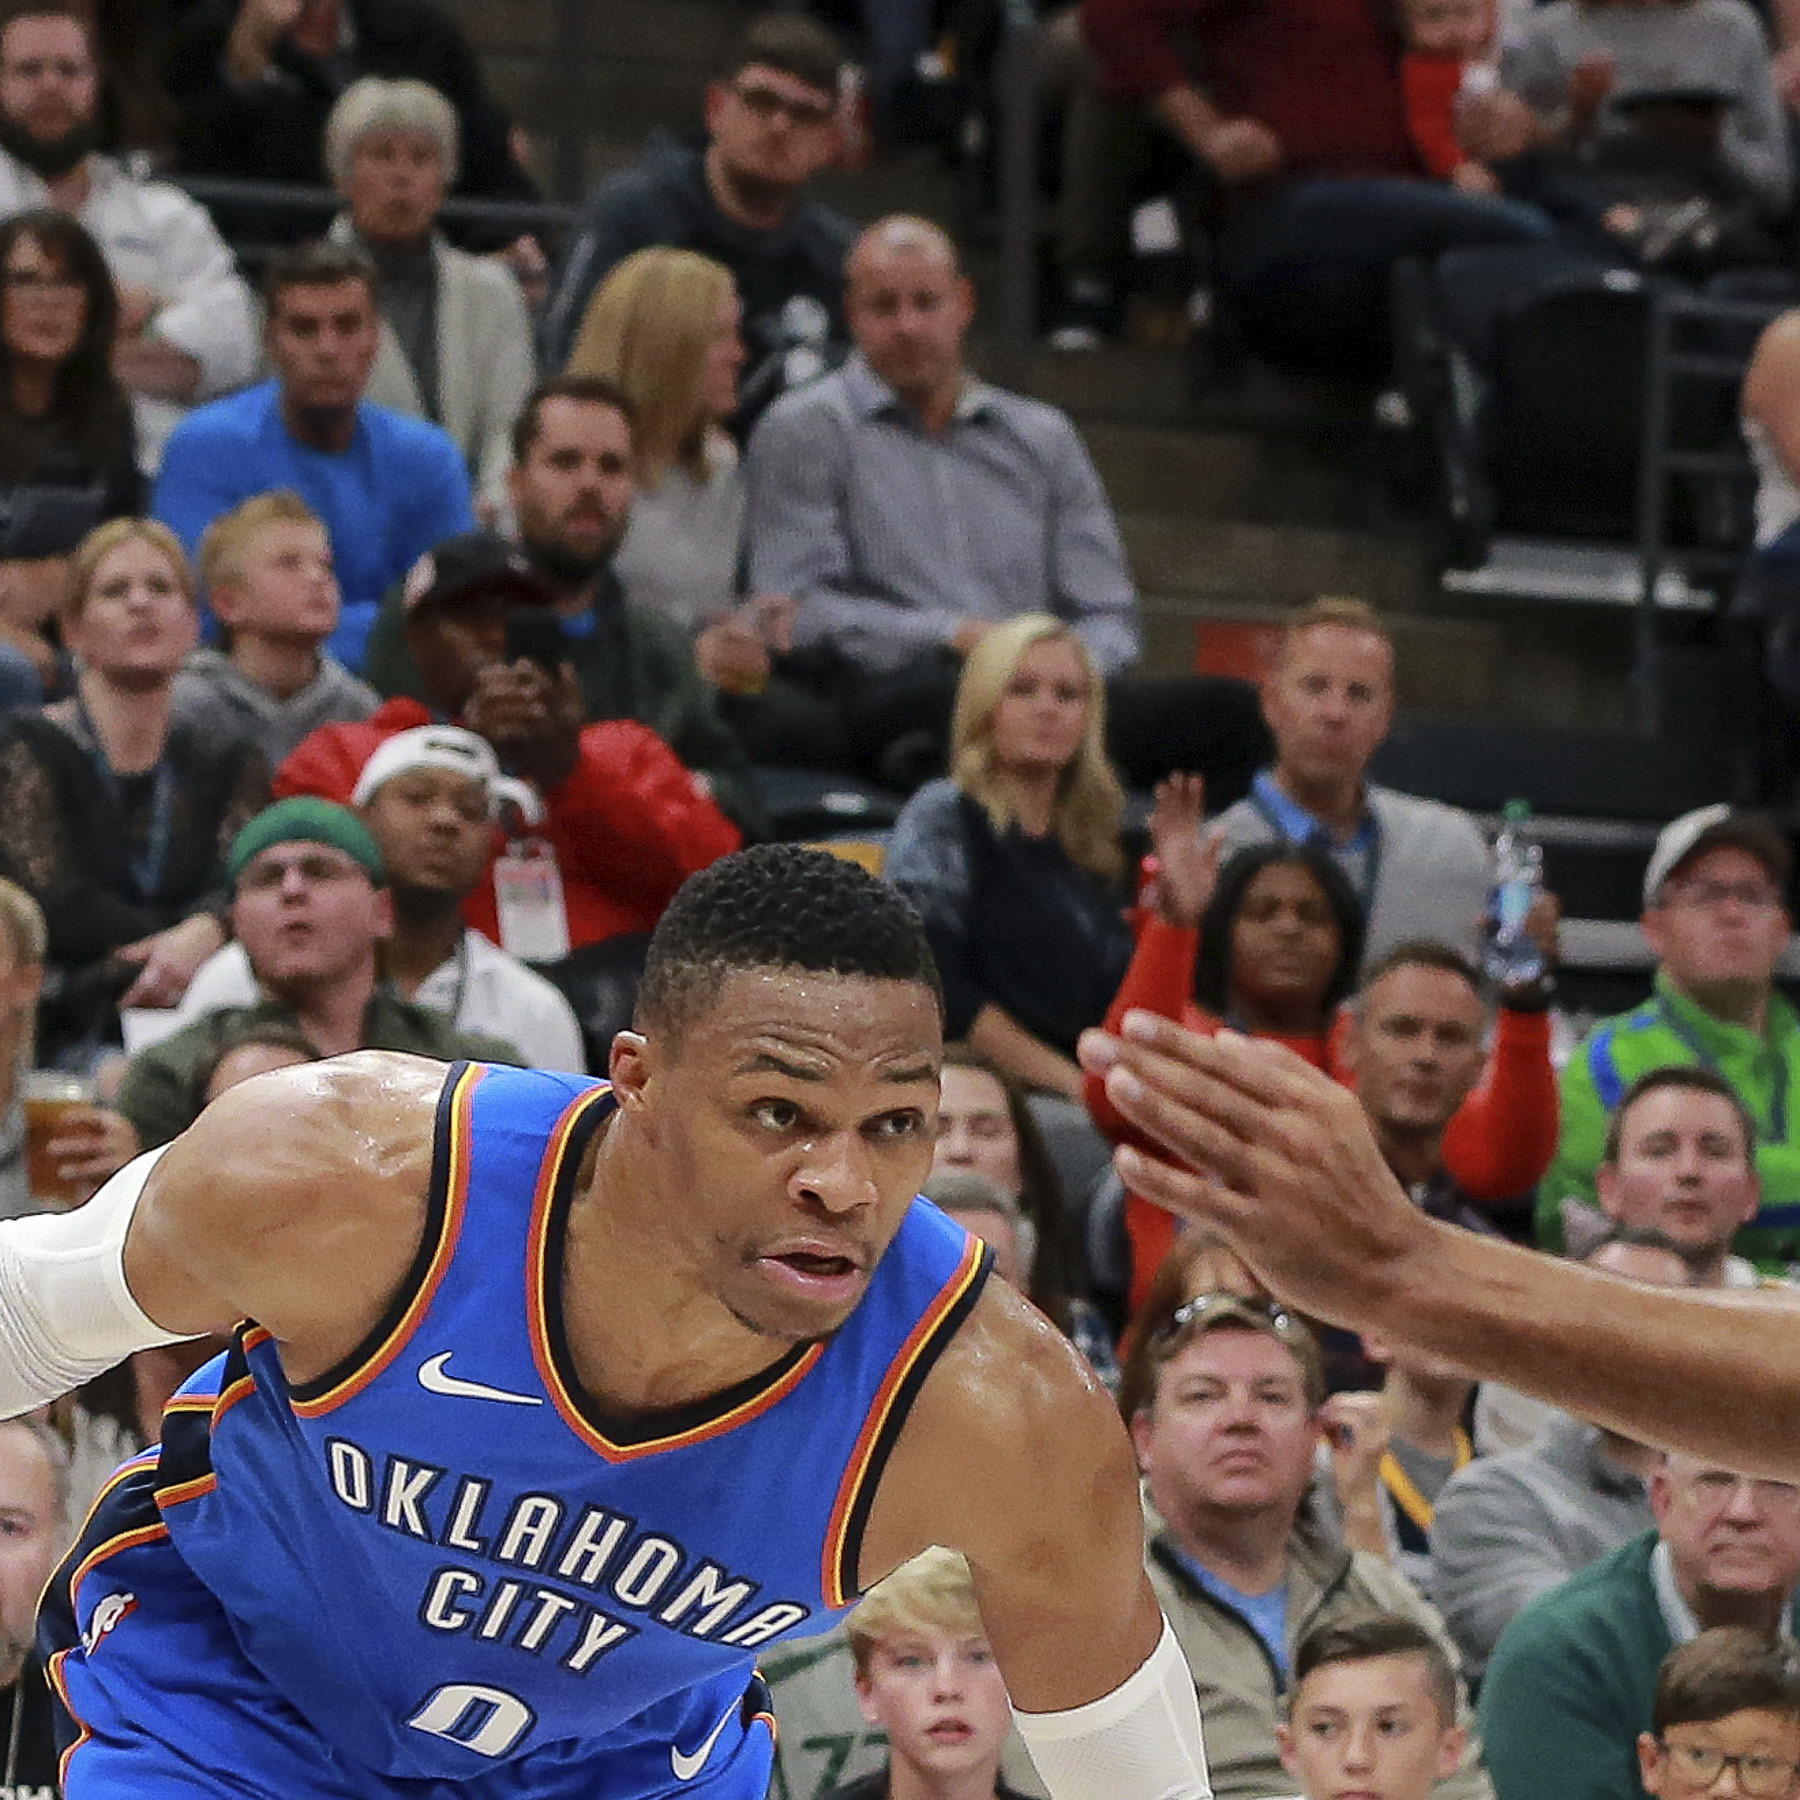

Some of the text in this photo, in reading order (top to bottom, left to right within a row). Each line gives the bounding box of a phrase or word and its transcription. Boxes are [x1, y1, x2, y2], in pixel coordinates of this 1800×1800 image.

[325, 1435, 811, 1651] OKLAHOMA
[418, 1565, 641, 1678] CITY
[406, 1682, 538, 1760] 0
